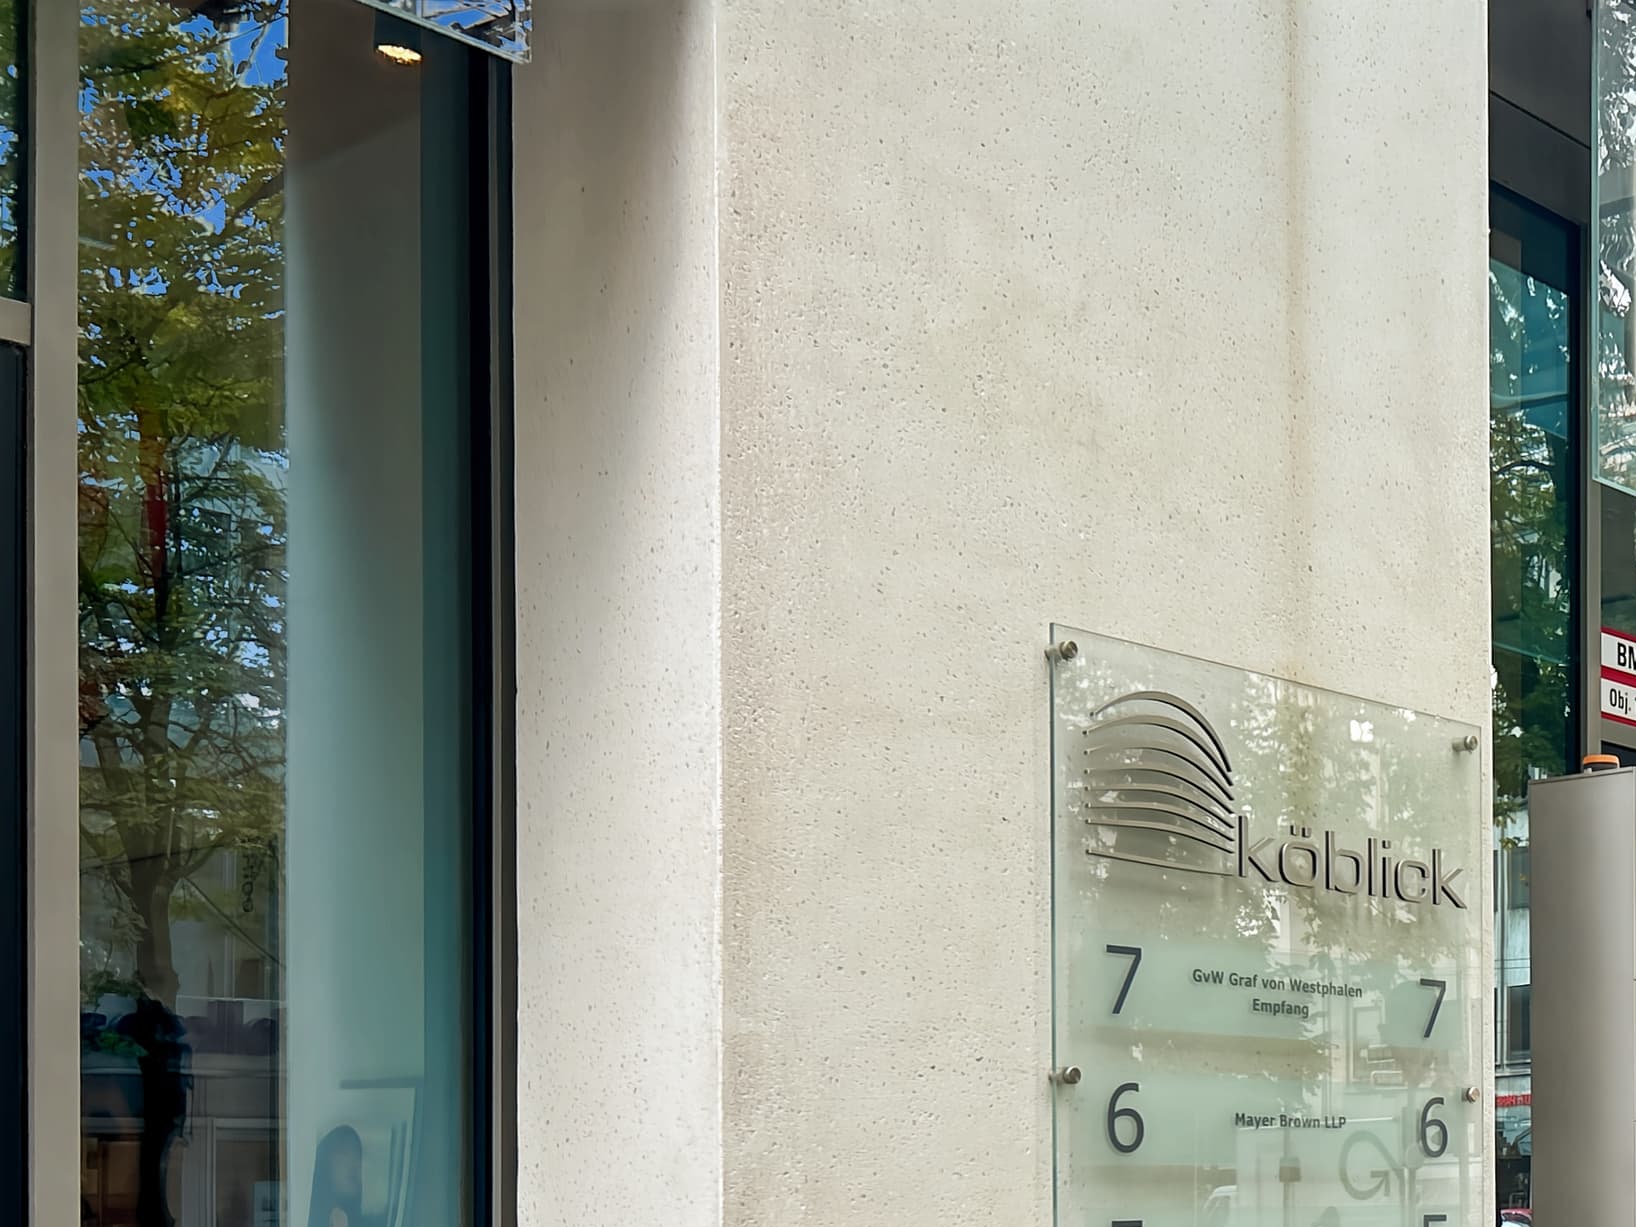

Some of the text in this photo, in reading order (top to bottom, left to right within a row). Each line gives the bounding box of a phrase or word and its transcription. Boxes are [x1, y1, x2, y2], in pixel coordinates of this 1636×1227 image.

[1609, 689, 1632, 714] Obj.
[1235, 815, 1467, 909] köblick
[1106, 945, 1142, 1015] 7
[1192, 969, 1362, 998] GvW Graf von Westphalen
[1253, 999, 1309, 1018] Empfang
[1419, 978, 1446, 1038] 7
[1107, 1082, 1144, 1153] 6
[1235, 1113, 1346, 1130] Mayer Brown LLP
[1420, 1097, 1448, 1158] 6
